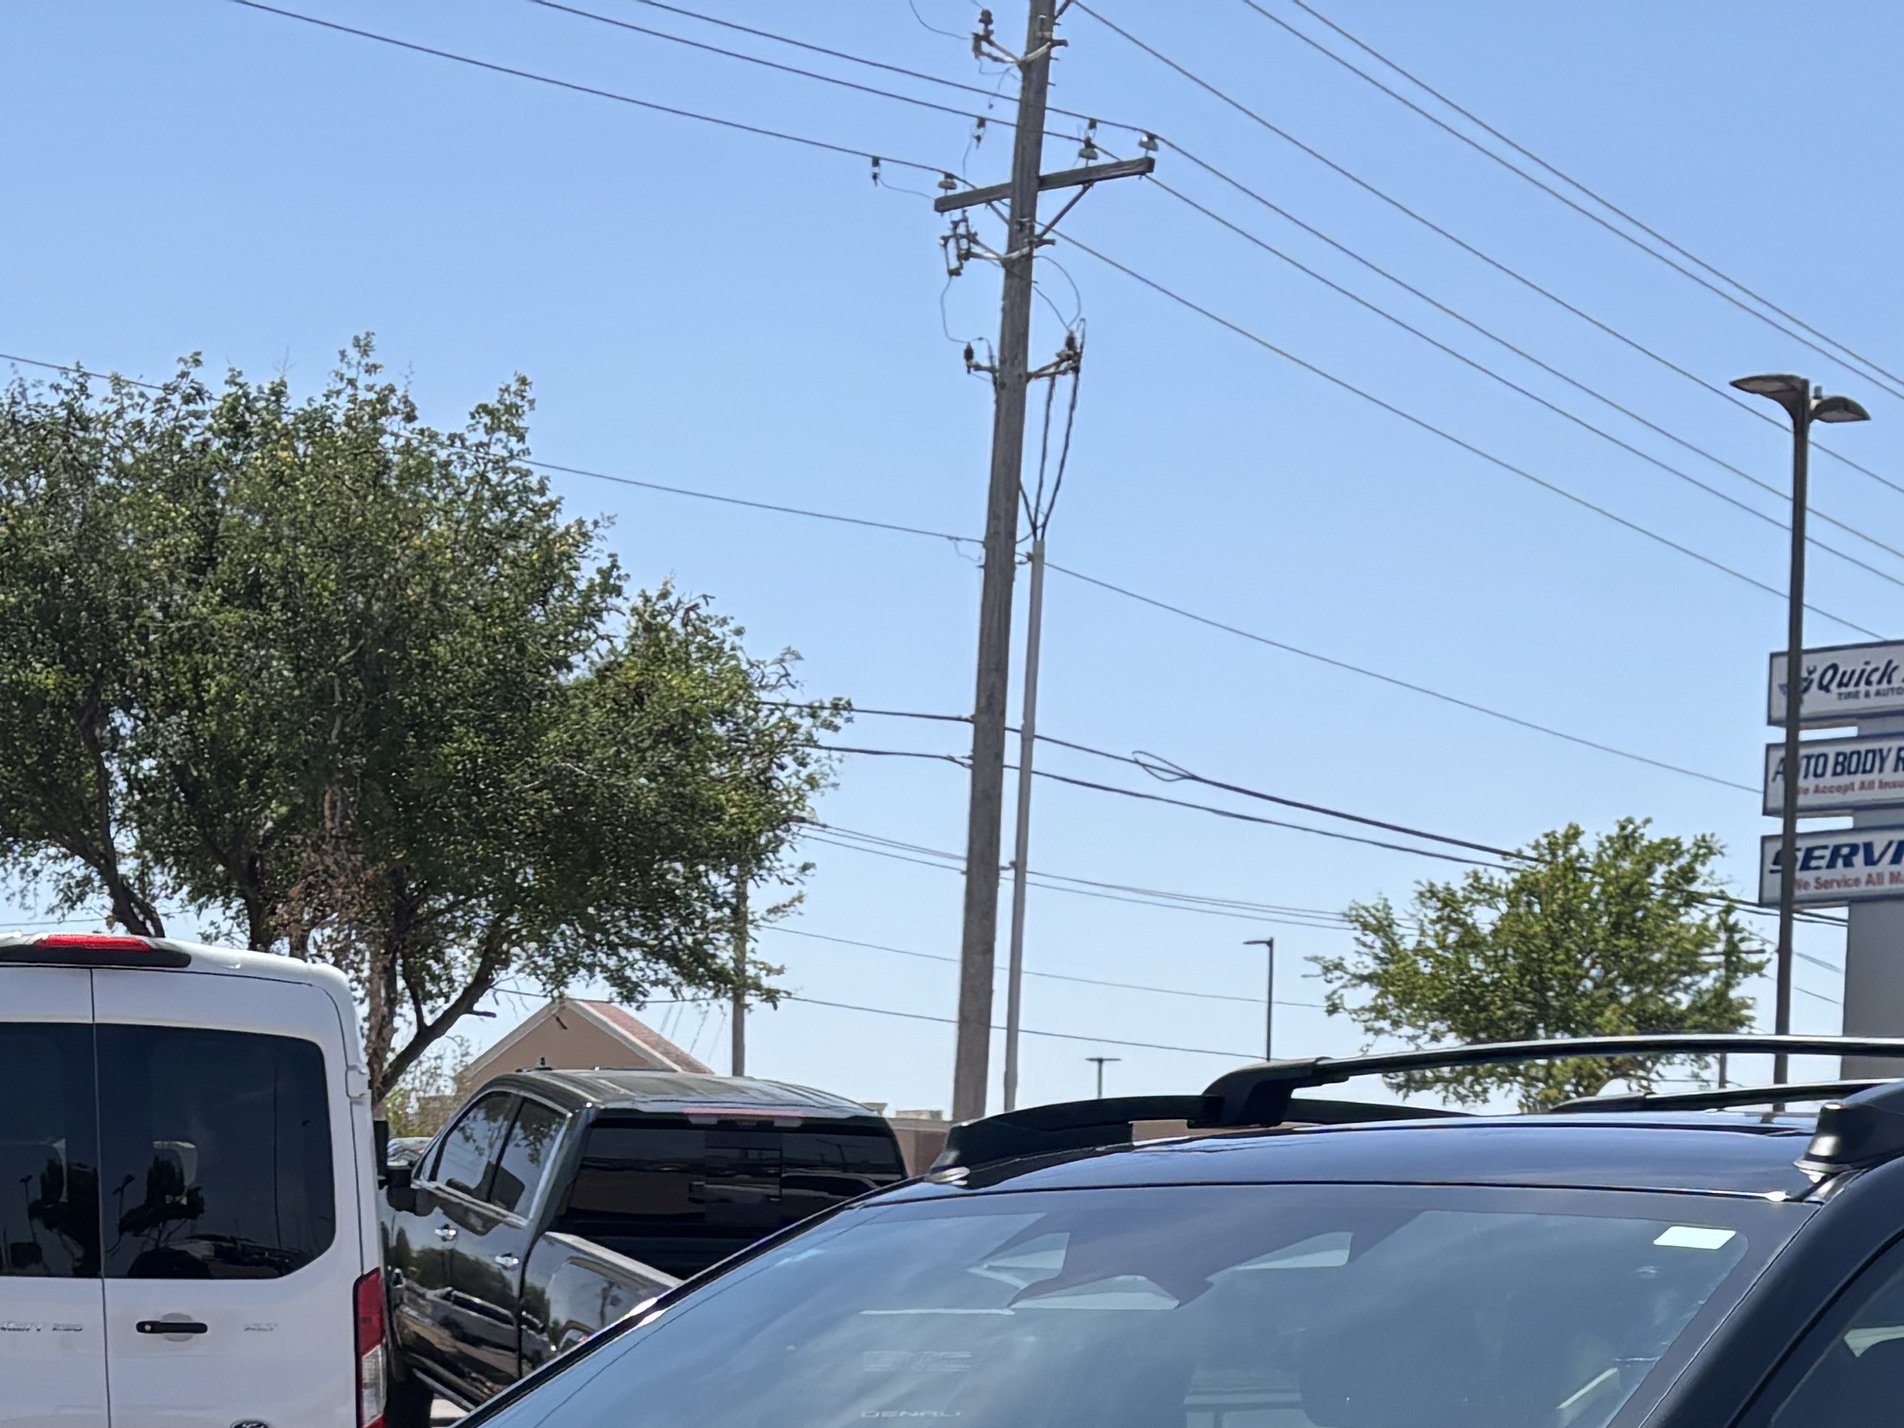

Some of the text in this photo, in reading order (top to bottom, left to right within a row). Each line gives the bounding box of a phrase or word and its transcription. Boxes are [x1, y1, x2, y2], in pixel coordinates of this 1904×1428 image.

[1816, 658, 1899, 694] Quick
[1837, 690, 1860, 701] TIRE
[1874, 686, 1904, 697] AUTO
[1772, 752, 1829, 783] ATO
[1831, 746, 1892, 777] BODY
[1813, 781, 1855, 796] Accept
[1858, 779, 1875, 791] All
[1814, 874, 1861, 890] Service
[1865, 872, 1884, 886] All
